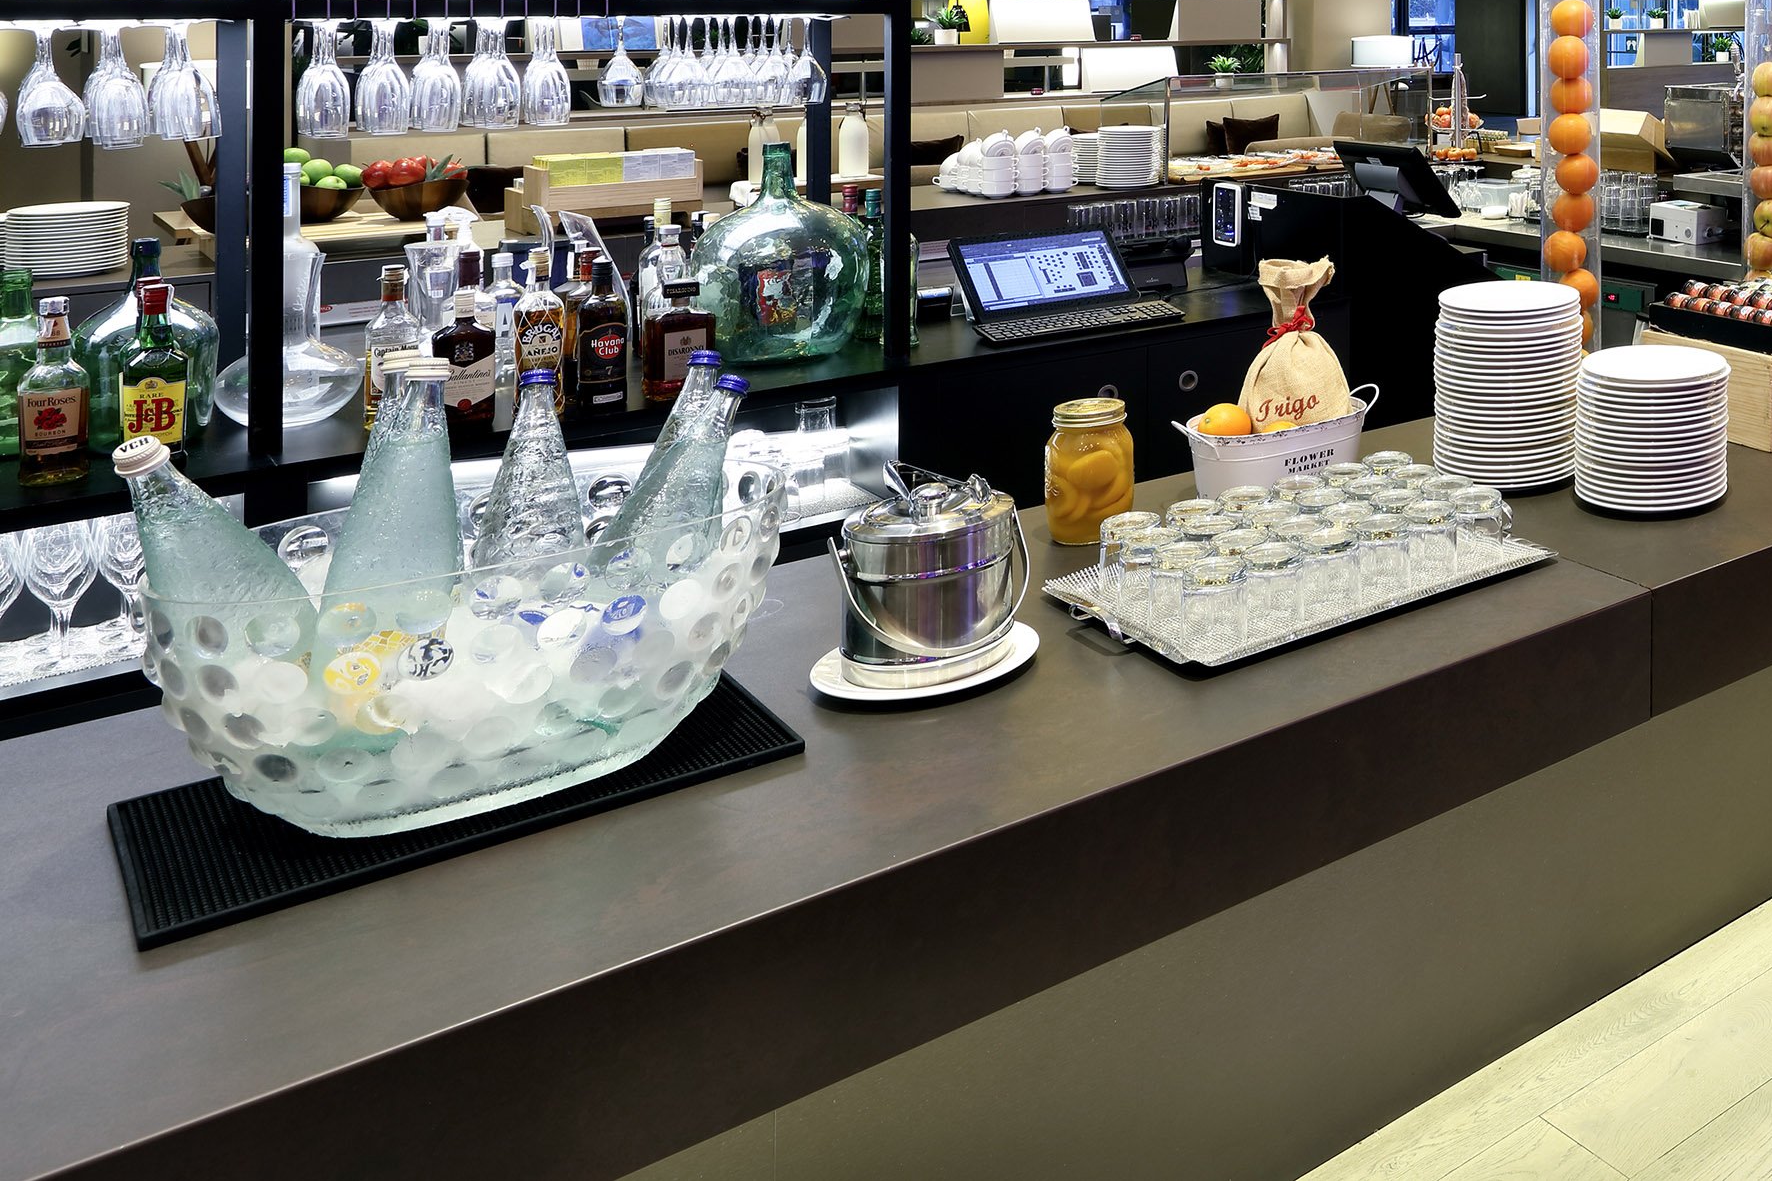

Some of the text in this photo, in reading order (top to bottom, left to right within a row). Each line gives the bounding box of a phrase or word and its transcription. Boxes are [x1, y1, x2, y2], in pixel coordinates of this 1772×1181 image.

[522, 323, 561, 344] BRUGAL
[591, 337, 624, 349] Havana
[526, 345, 558, 357] AÑEJO
[598, 347, 620, 356] Club
[605, 365, 613, 375] 7
[27, 397, 50, 408] Four
[128, 397, 176, 433] J&B
[34, 429, 66, 437] BOURBON
[118, 437, 150, 453] VCH
[1284, 448, 1334, 467] FLOWER
[1288, 459, 1330, 474] MARKET
